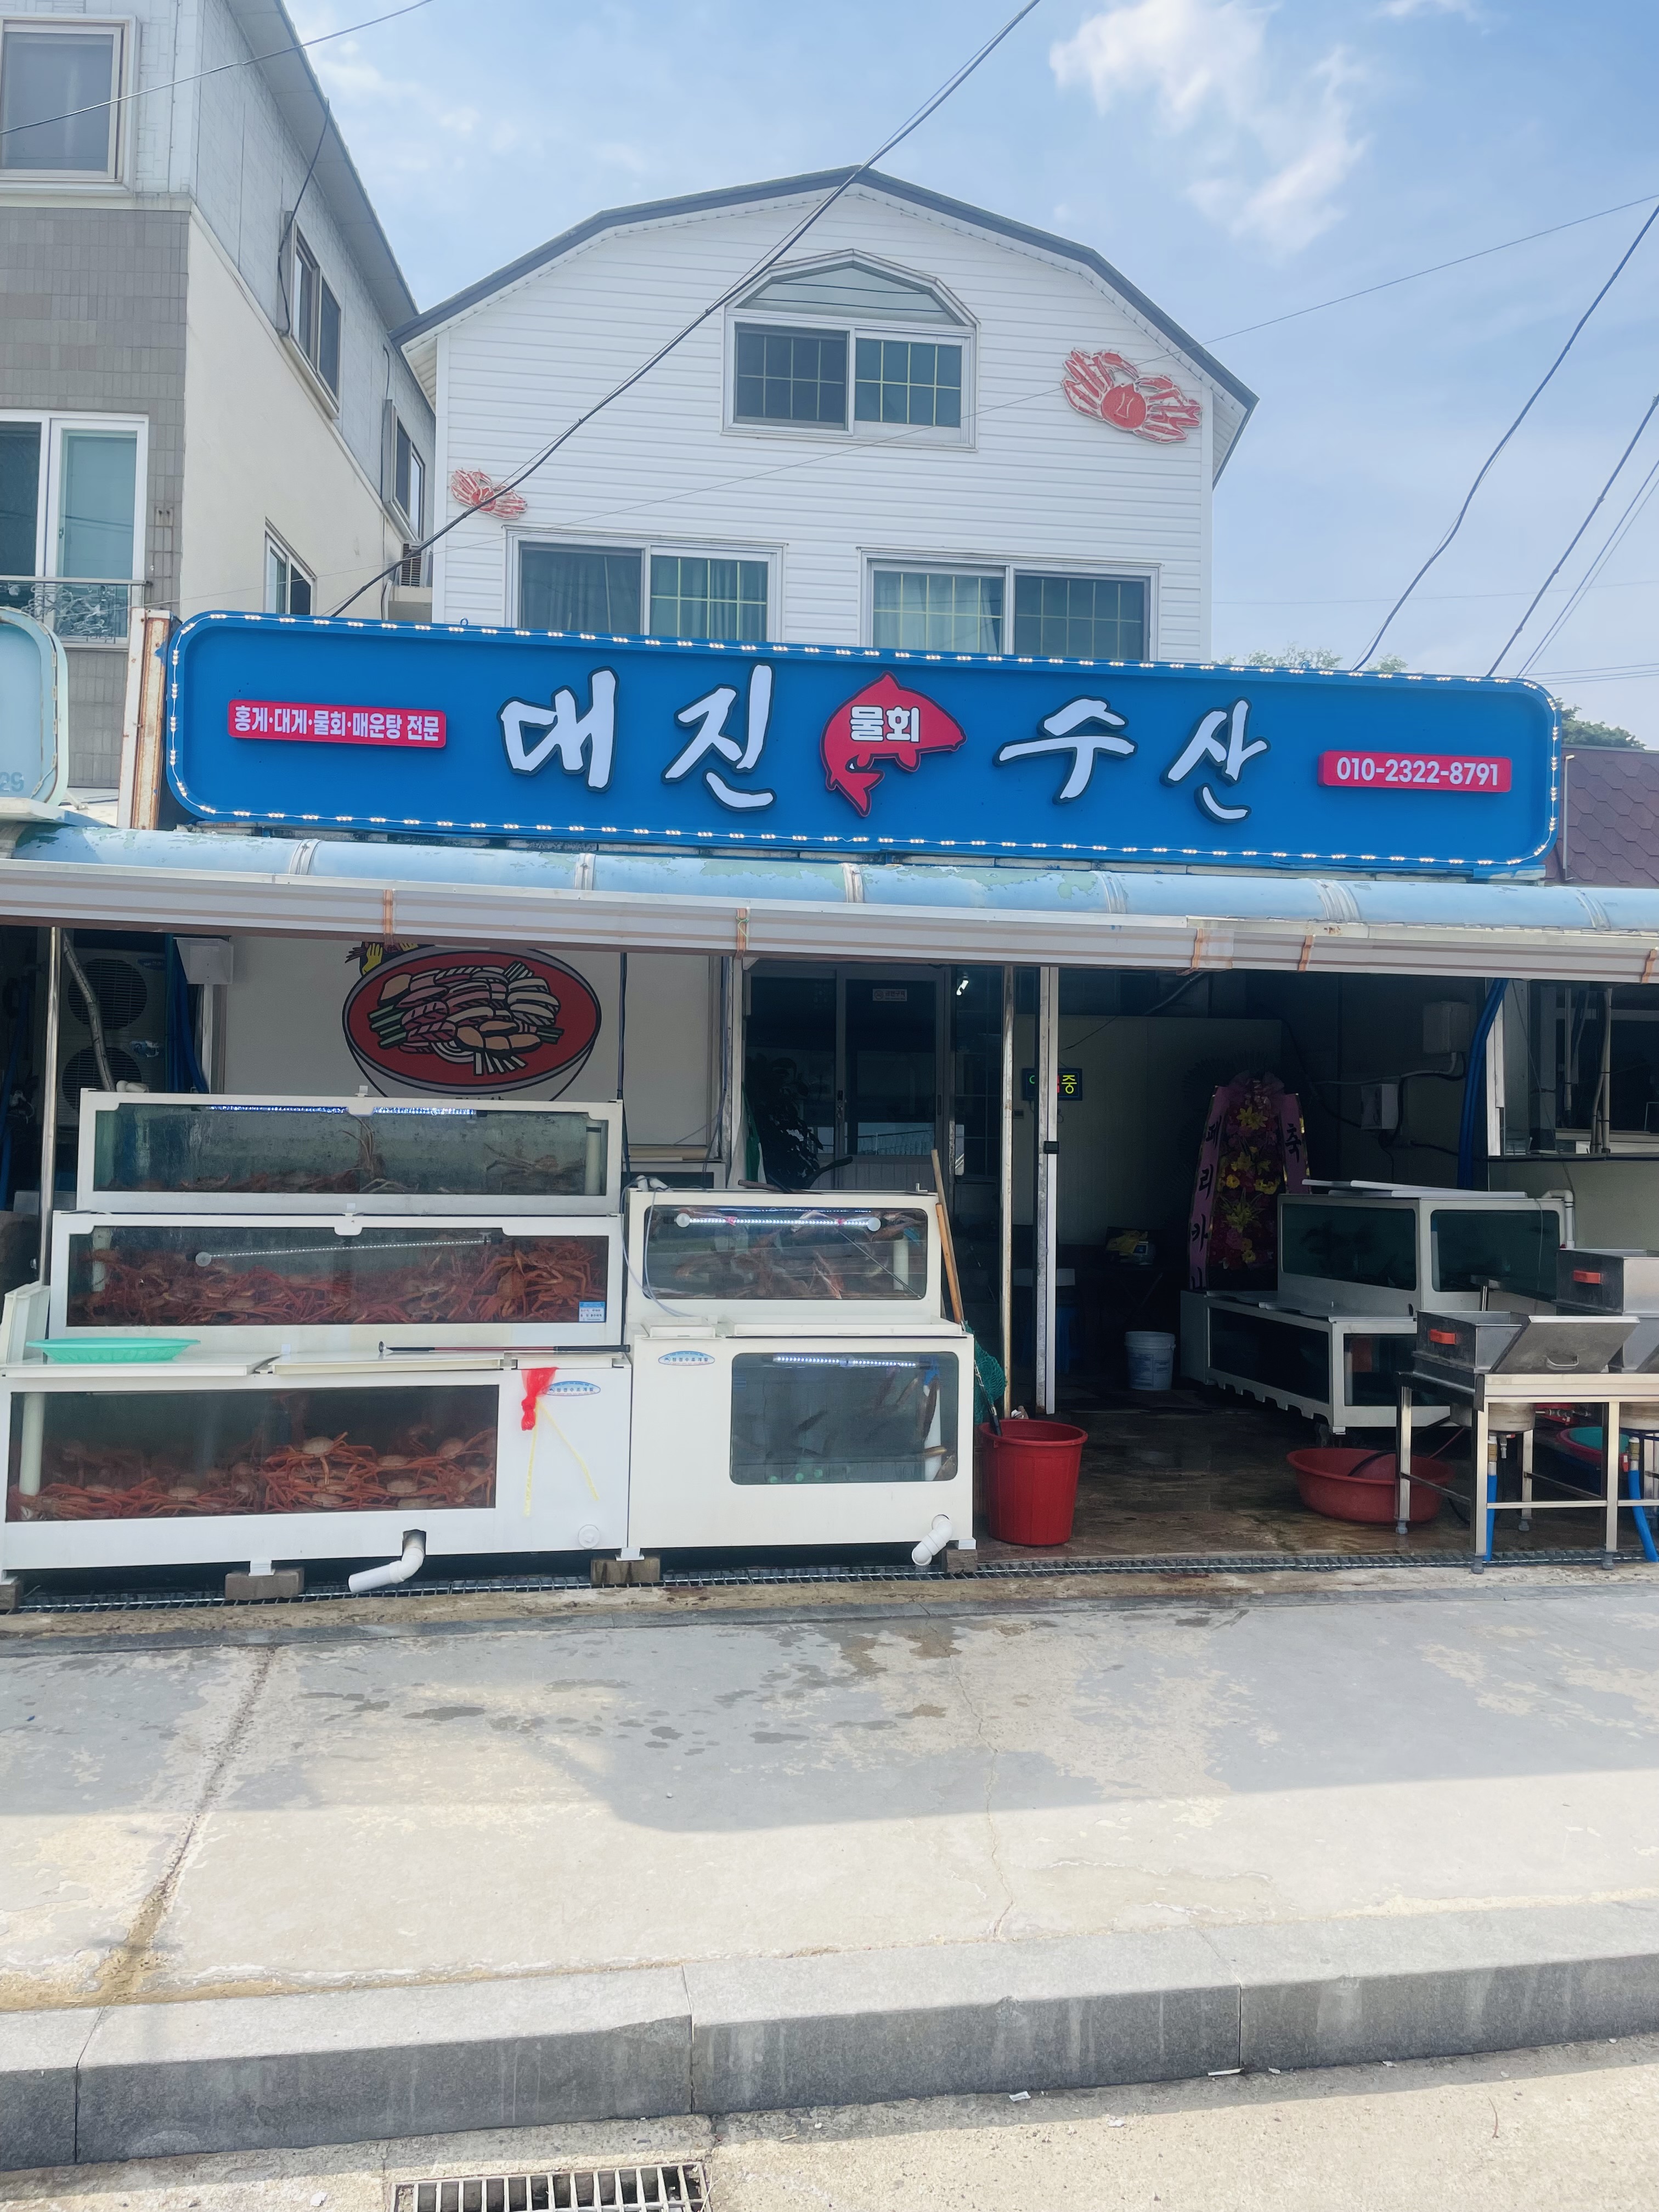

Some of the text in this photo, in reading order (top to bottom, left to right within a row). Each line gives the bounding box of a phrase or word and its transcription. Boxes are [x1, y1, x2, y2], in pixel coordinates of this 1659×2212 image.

[407, 715, 439, 741] 전문
[850, 706, 919, 743] 물회
[500, 664, 1268, 820] 대진 수산
[1336, 757, 1498, 786] 010-2322-8791
